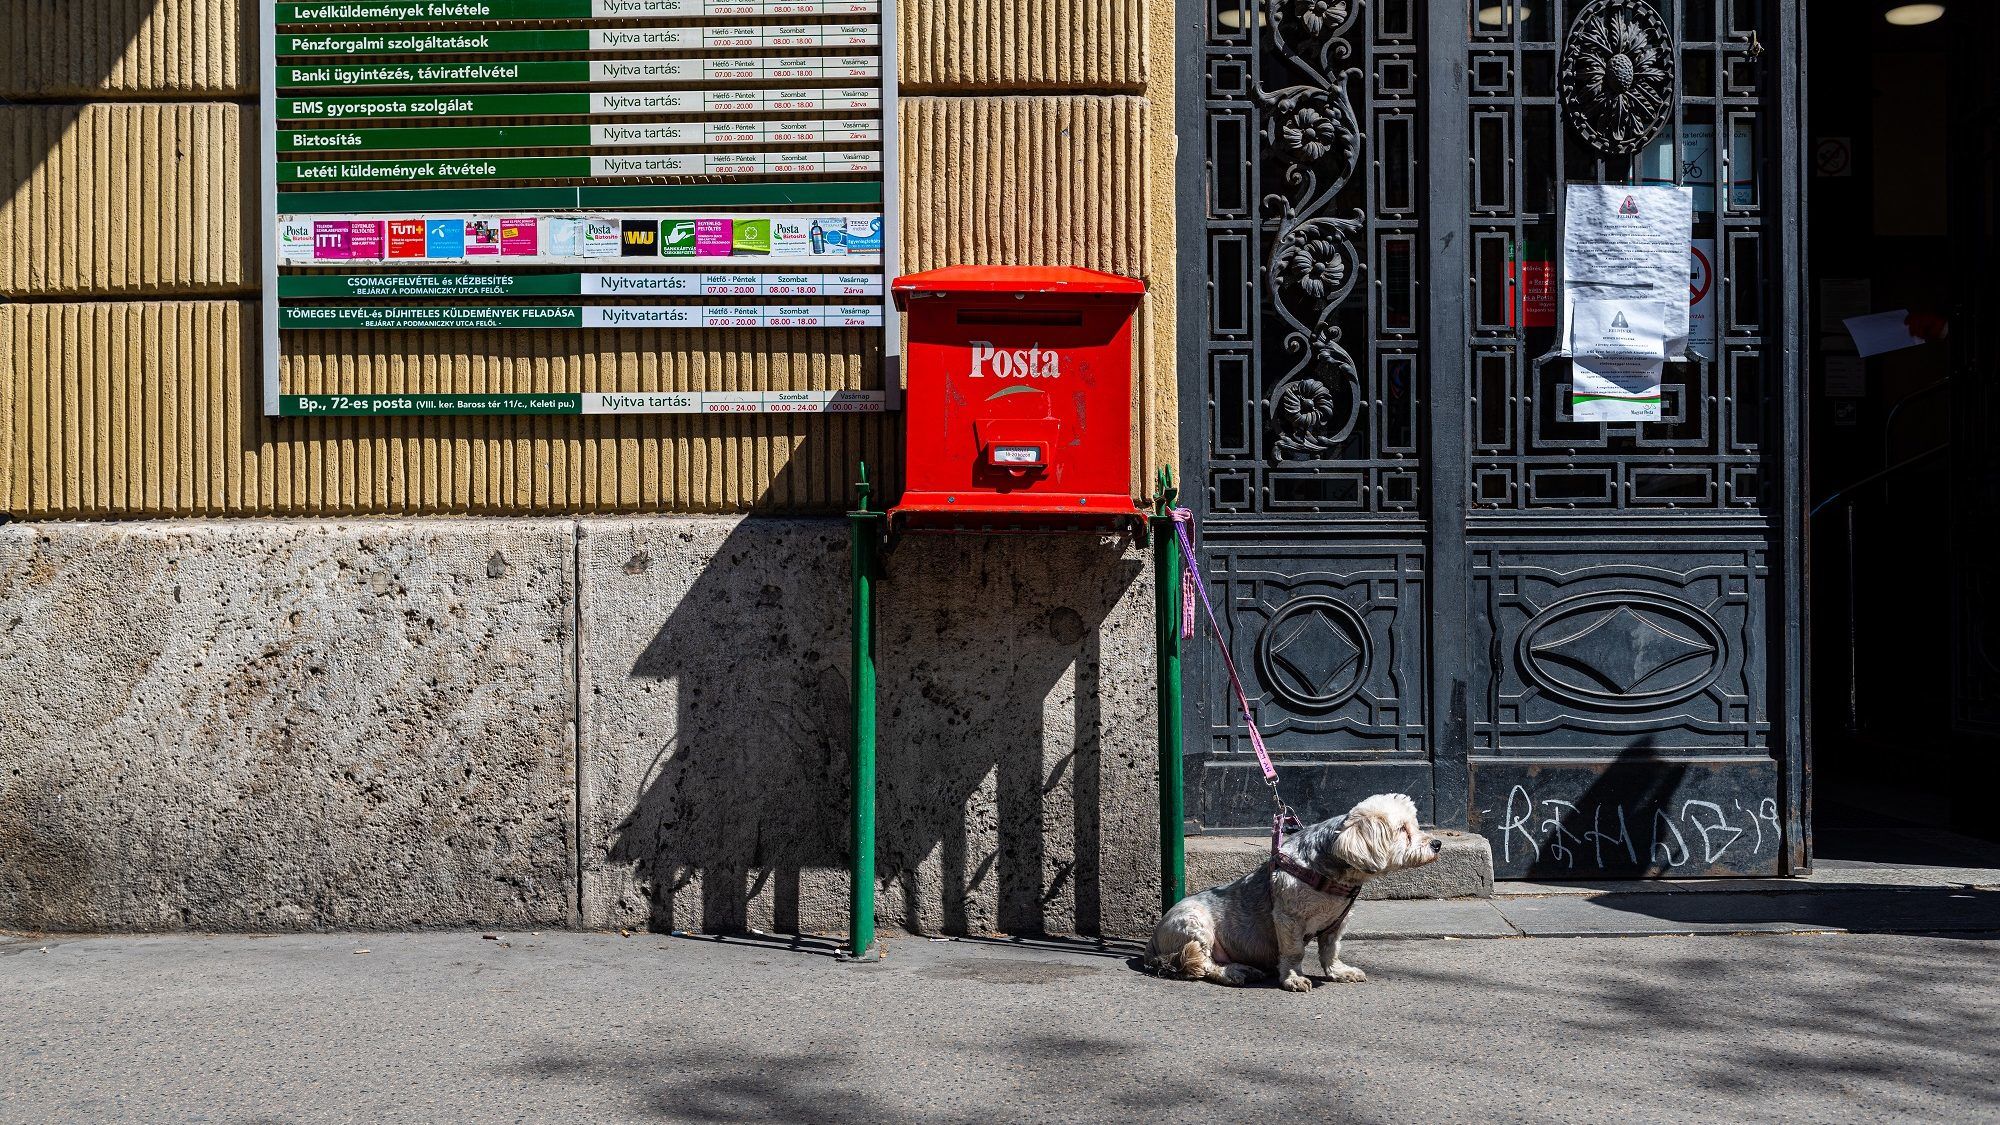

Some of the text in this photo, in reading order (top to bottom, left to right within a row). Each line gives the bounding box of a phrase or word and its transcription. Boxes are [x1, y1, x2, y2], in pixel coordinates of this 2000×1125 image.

[604, 0, 680, 12] Nyitva tartás:
[736, 6, 754, 14] 20.00
[797, 5, 814, 13] 18.00
[295, 3, 489, 19] Levélküldemények felvétele
[603, 31, 679, 45] Nyitva tartás:
[796, 37, 813, 45] 18.00
[293, 35, 488, 53] Pénzforgalmi szolgáltatások
[841, 58, 869, 66] Vasárnap
[292, 65, 517, 83] Banki ügyintézés, táviratfelvétel
[604, 63, 680, 76] Nyitva tartás:
[604, 95, 680, 108] Nyitva tartás:
[736, 102, 753, 110] 20.00
[293, 99, 473, 116] EMS gyorsposta szolgálat
[605, 127, 680, 140] Nyitva tartás:
[715, 134, 733, 142] 07.00
[294, 134, 361, 146] Biztosítás
[605, 158, 681, 172] Nyitva tartás:
[737, 165, 754, 173] 20.00
[297, 163, 496, 181] Letéti küldemények átvétele
[287, 226, 308, 235] Posta
[589, 224, 610, 234] Posta
[777, 224, 799, 233] Posta
[316, 234, 342, 247] ITT!
[347, 275, 513, 287] CSOMAGFELVÉTEL és KÉZBESÍTÉS
[602, 277, 685, 290] Nyitvatartás:
[707, 275, 756, 283] Hétfő Péntek
[778, 275, 808, 283] Szombat
[839, 276, 869, 285] Vasárnap
[357, 287, 389, 295] BEJÁRAT
[734, 286, 755, 294] 20.00
[769, 286, 790, 294] 08.00
[287, 307, 574, 318] TÖMEGES LEVÉL-és DÍJHITELES KÜLDEMÉNYEK FELADÁSA
[603, 309, 687, 322] Nyitvatartás:
[708, 307, 758, 315] Hétfő Péntek
[779, 307, 809, 315] Szombat
[840, 307, 870, 315] Vasárnap
[365, 319, 395, 327] BEJÁRAT
[709, 318, 757, 326] 07.00 20.00
[770, 318, 791, 326] 08.00
[844, 318, 865, 326] Zárva
[969, 341, 1061, 378] Posta
[300, 397, 574, 412] Bp., 72-es posta (VIII. ker. Baross tér 11/c., Keleti pu.)
[603, 395, 690, 408] Nyitva tartás:
[709, 404, 756, 412] 00.00 24.00
[770, 404, 791, 412] 00.00
